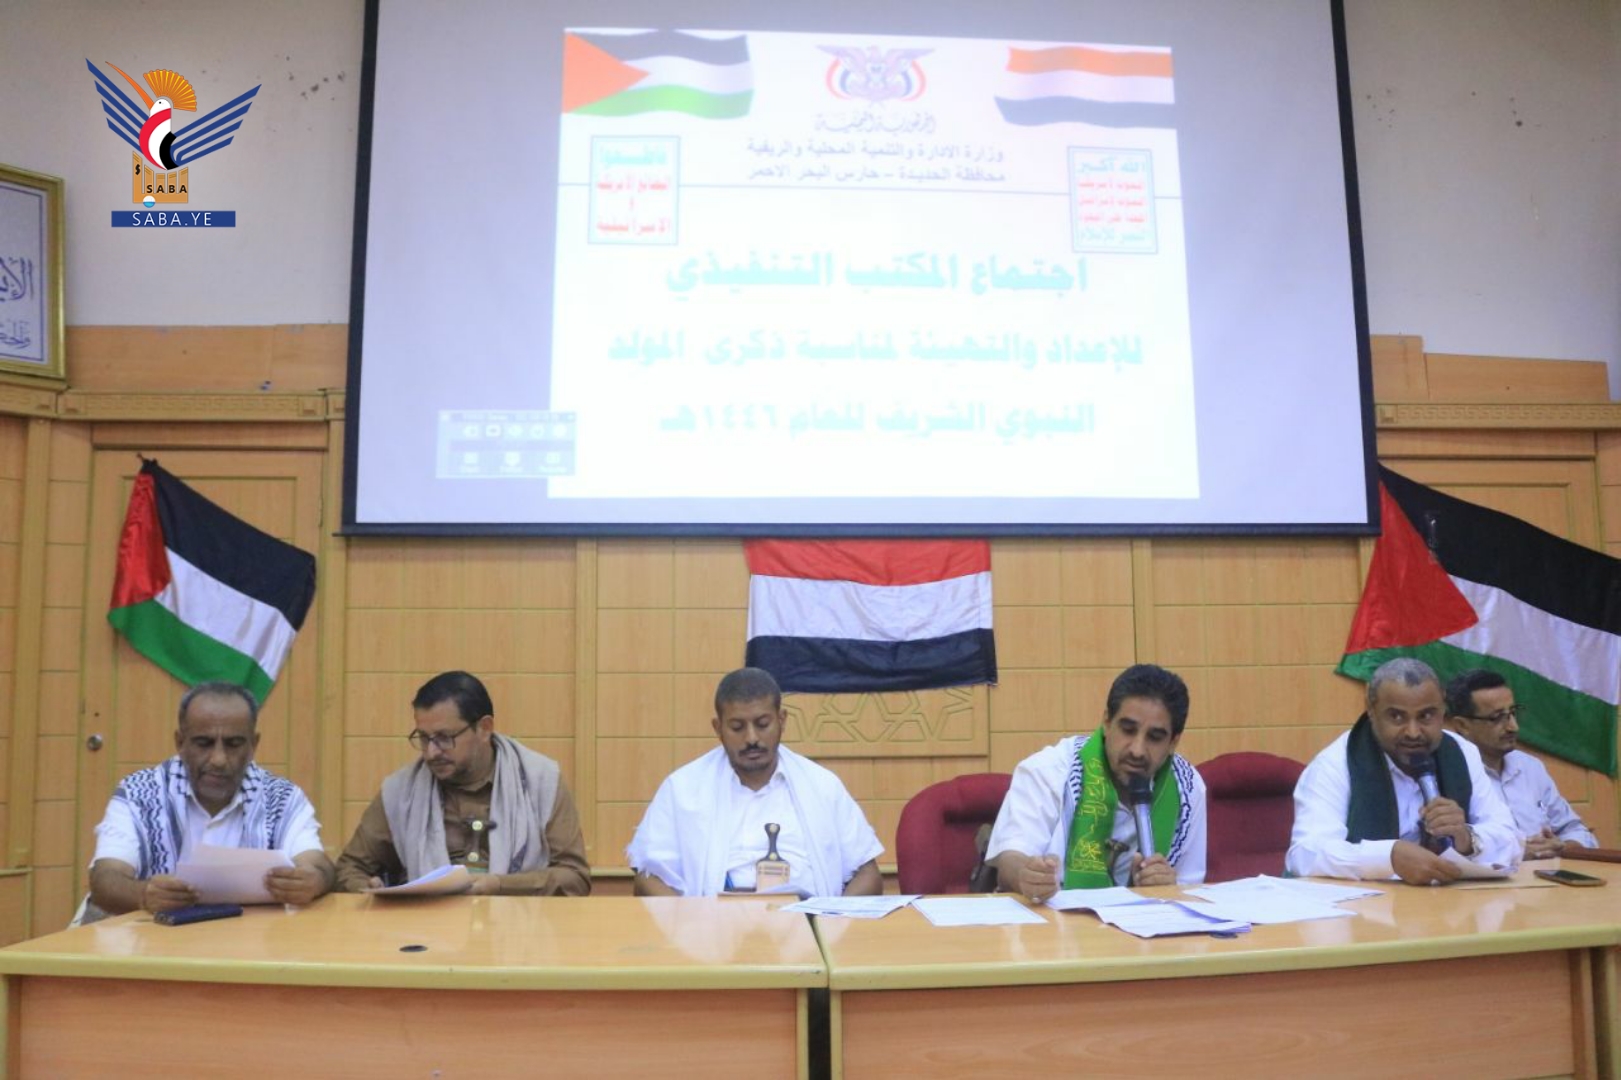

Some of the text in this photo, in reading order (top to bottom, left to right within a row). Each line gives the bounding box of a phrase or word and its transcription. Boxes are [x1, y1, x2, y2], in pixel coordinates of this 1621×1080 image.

[666, 251, 1087, 302] اجتماع المكتب التنفيذي
[876, 402, 986, 439] الشريف
[995, 403, 1095, 446] النبوي
